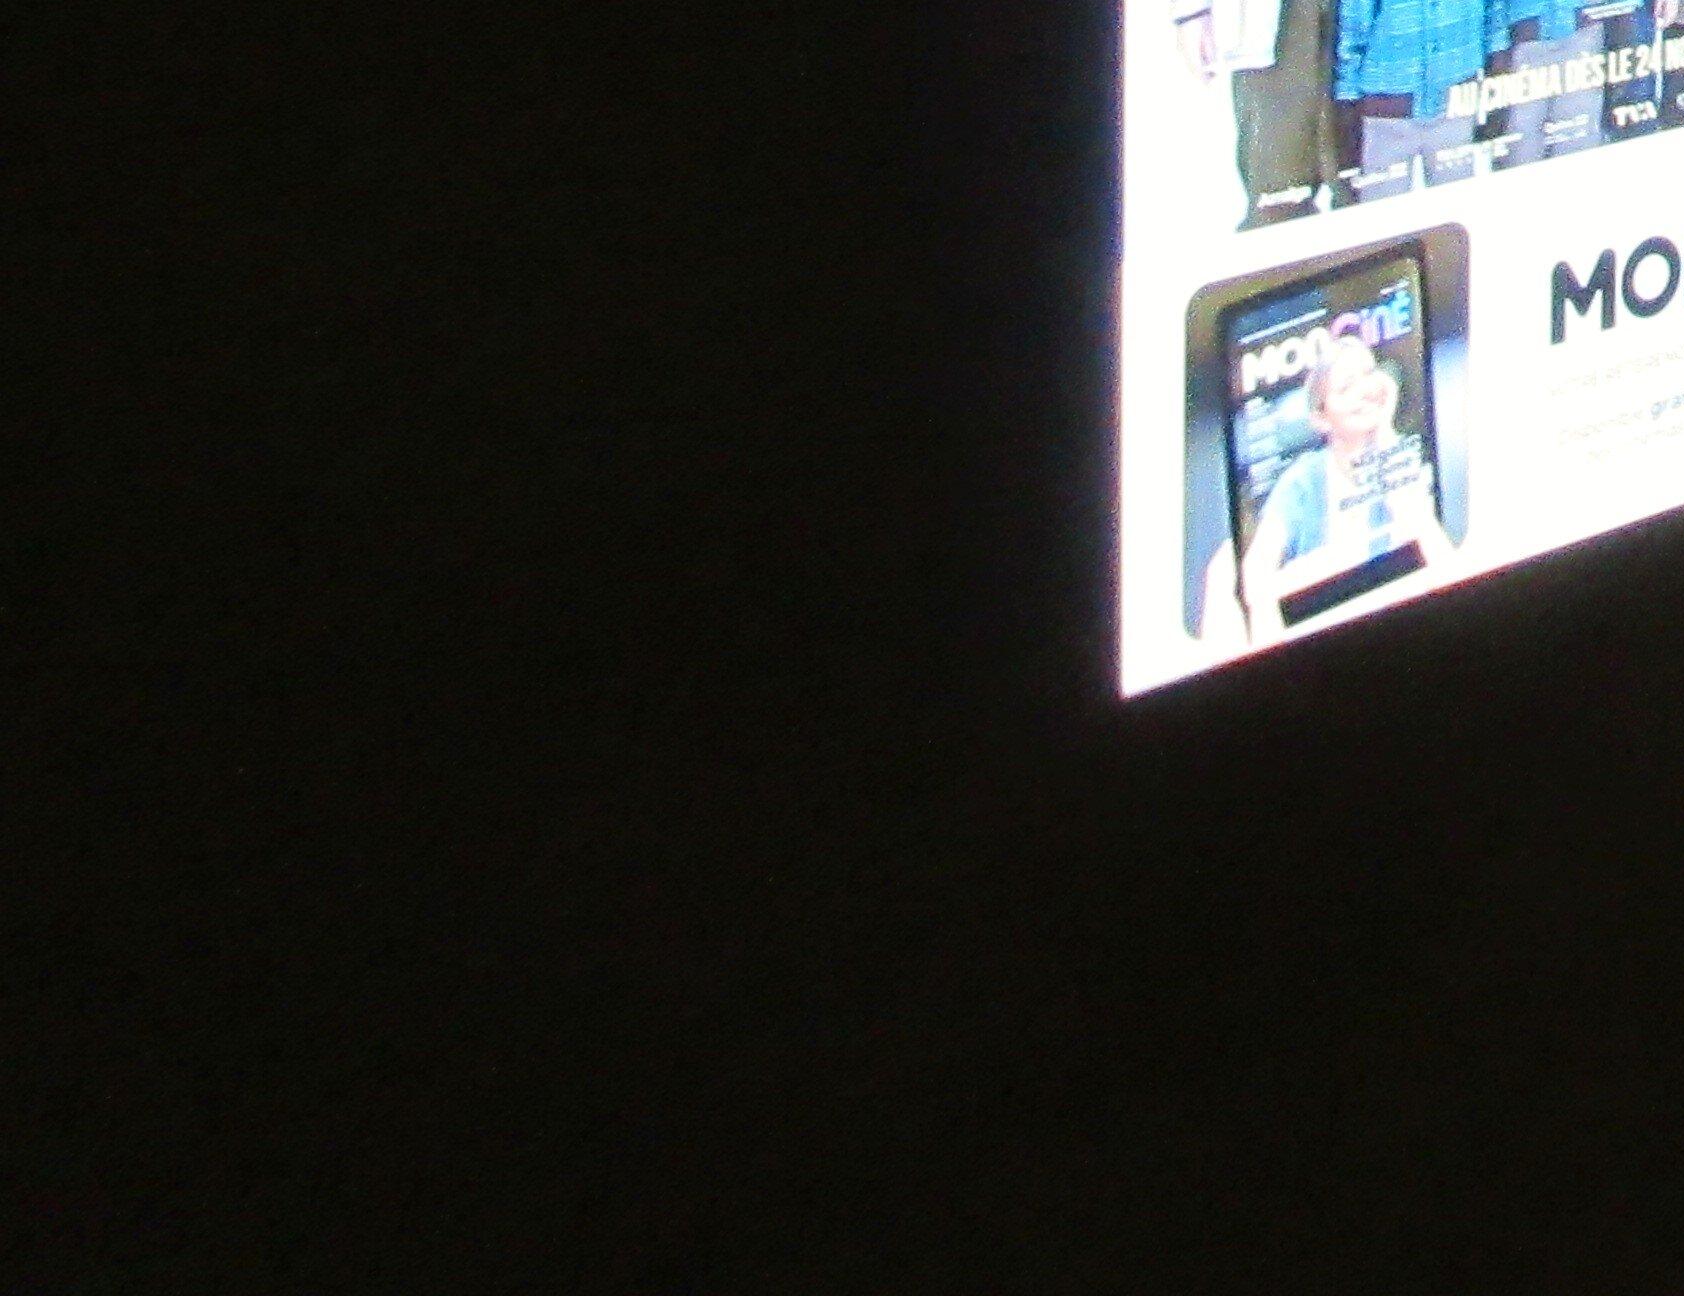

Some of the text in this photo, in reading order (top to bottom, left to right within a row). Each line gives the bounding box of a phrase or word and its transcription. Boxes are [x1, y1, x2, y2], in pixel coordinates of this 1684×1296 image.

[1446, 82, 1478, 118] AU
[1482, 63, 1562, 112] CINÉMA
[1564, 51, 1605, 93] DÈS
[1608, 50, 1634, 84] LE
